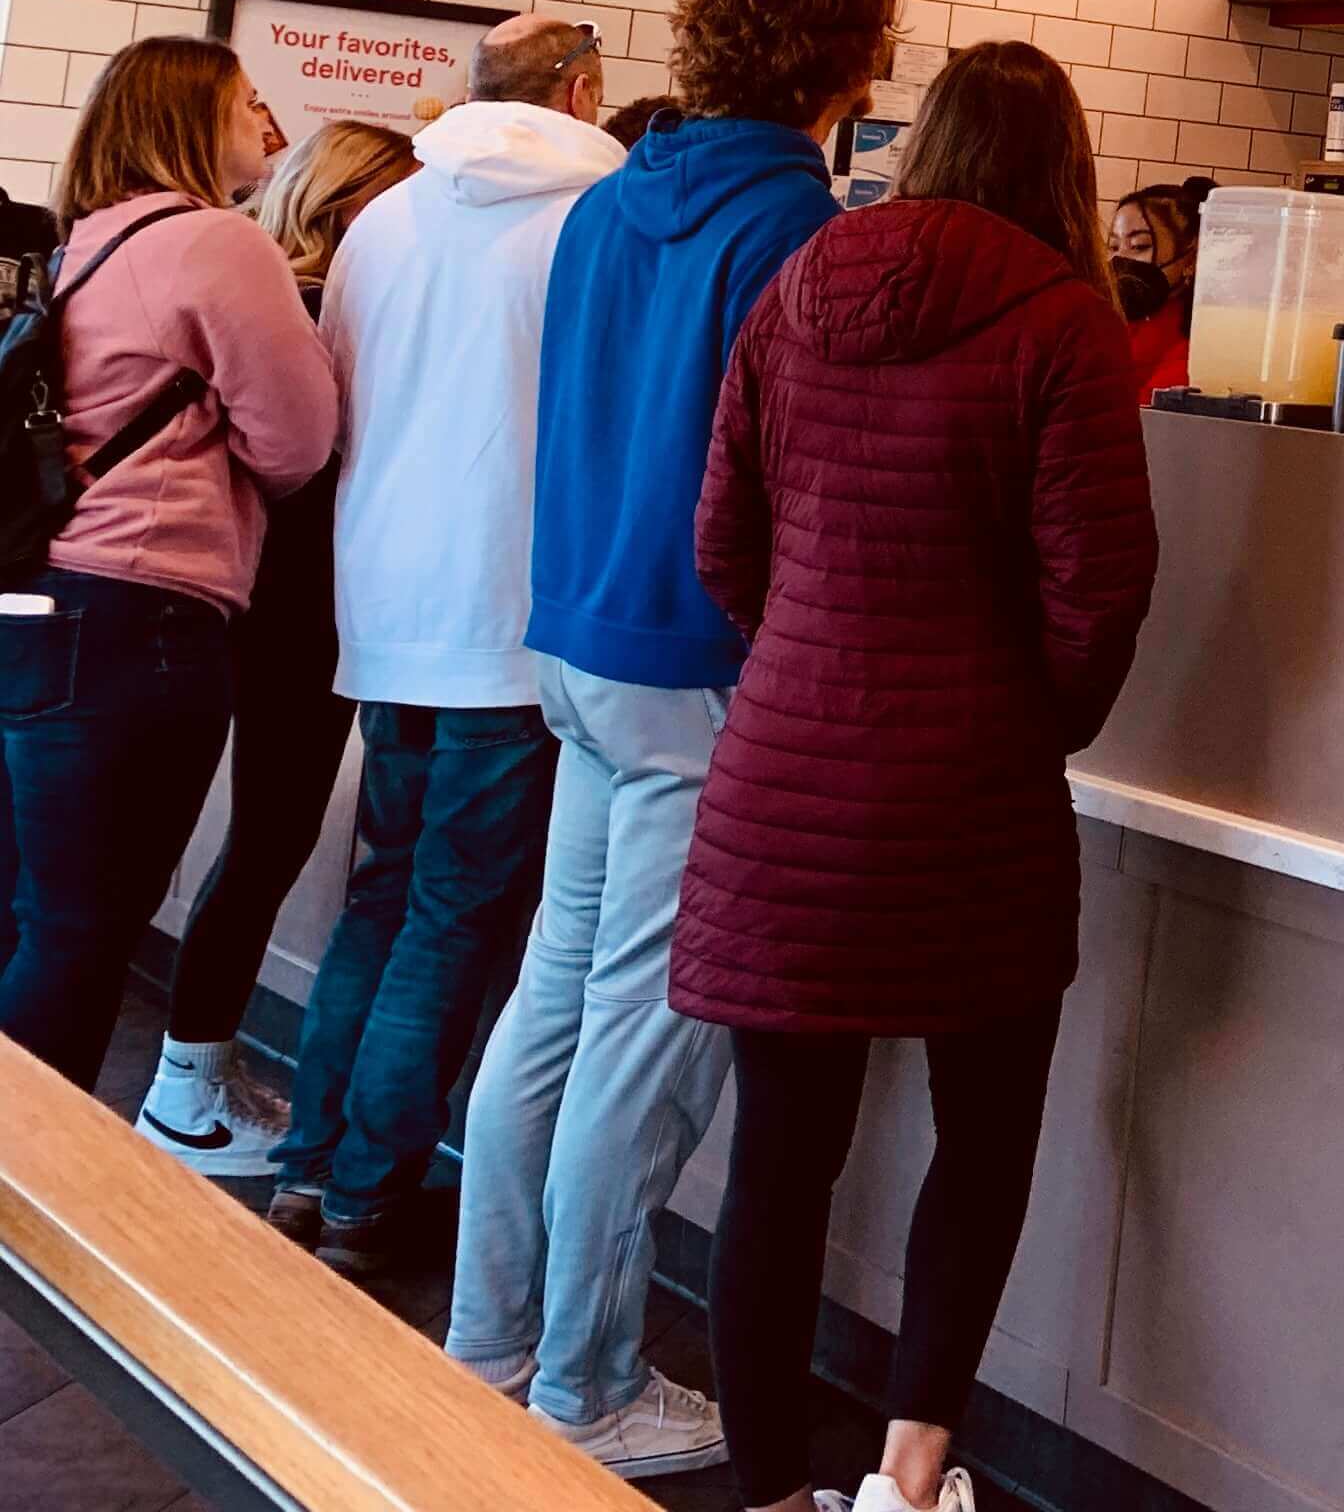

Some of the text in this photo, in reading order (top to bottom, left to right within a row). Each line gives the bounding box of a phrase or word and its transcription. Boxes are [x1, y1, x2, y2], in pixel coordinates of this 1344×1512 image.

[271, 23, 456, 67] Your favorites,
[302, 57, 422, 88] delivered
[304, 104, 326, 114] Enjoy
[354, 108, 379, 117] smiles
